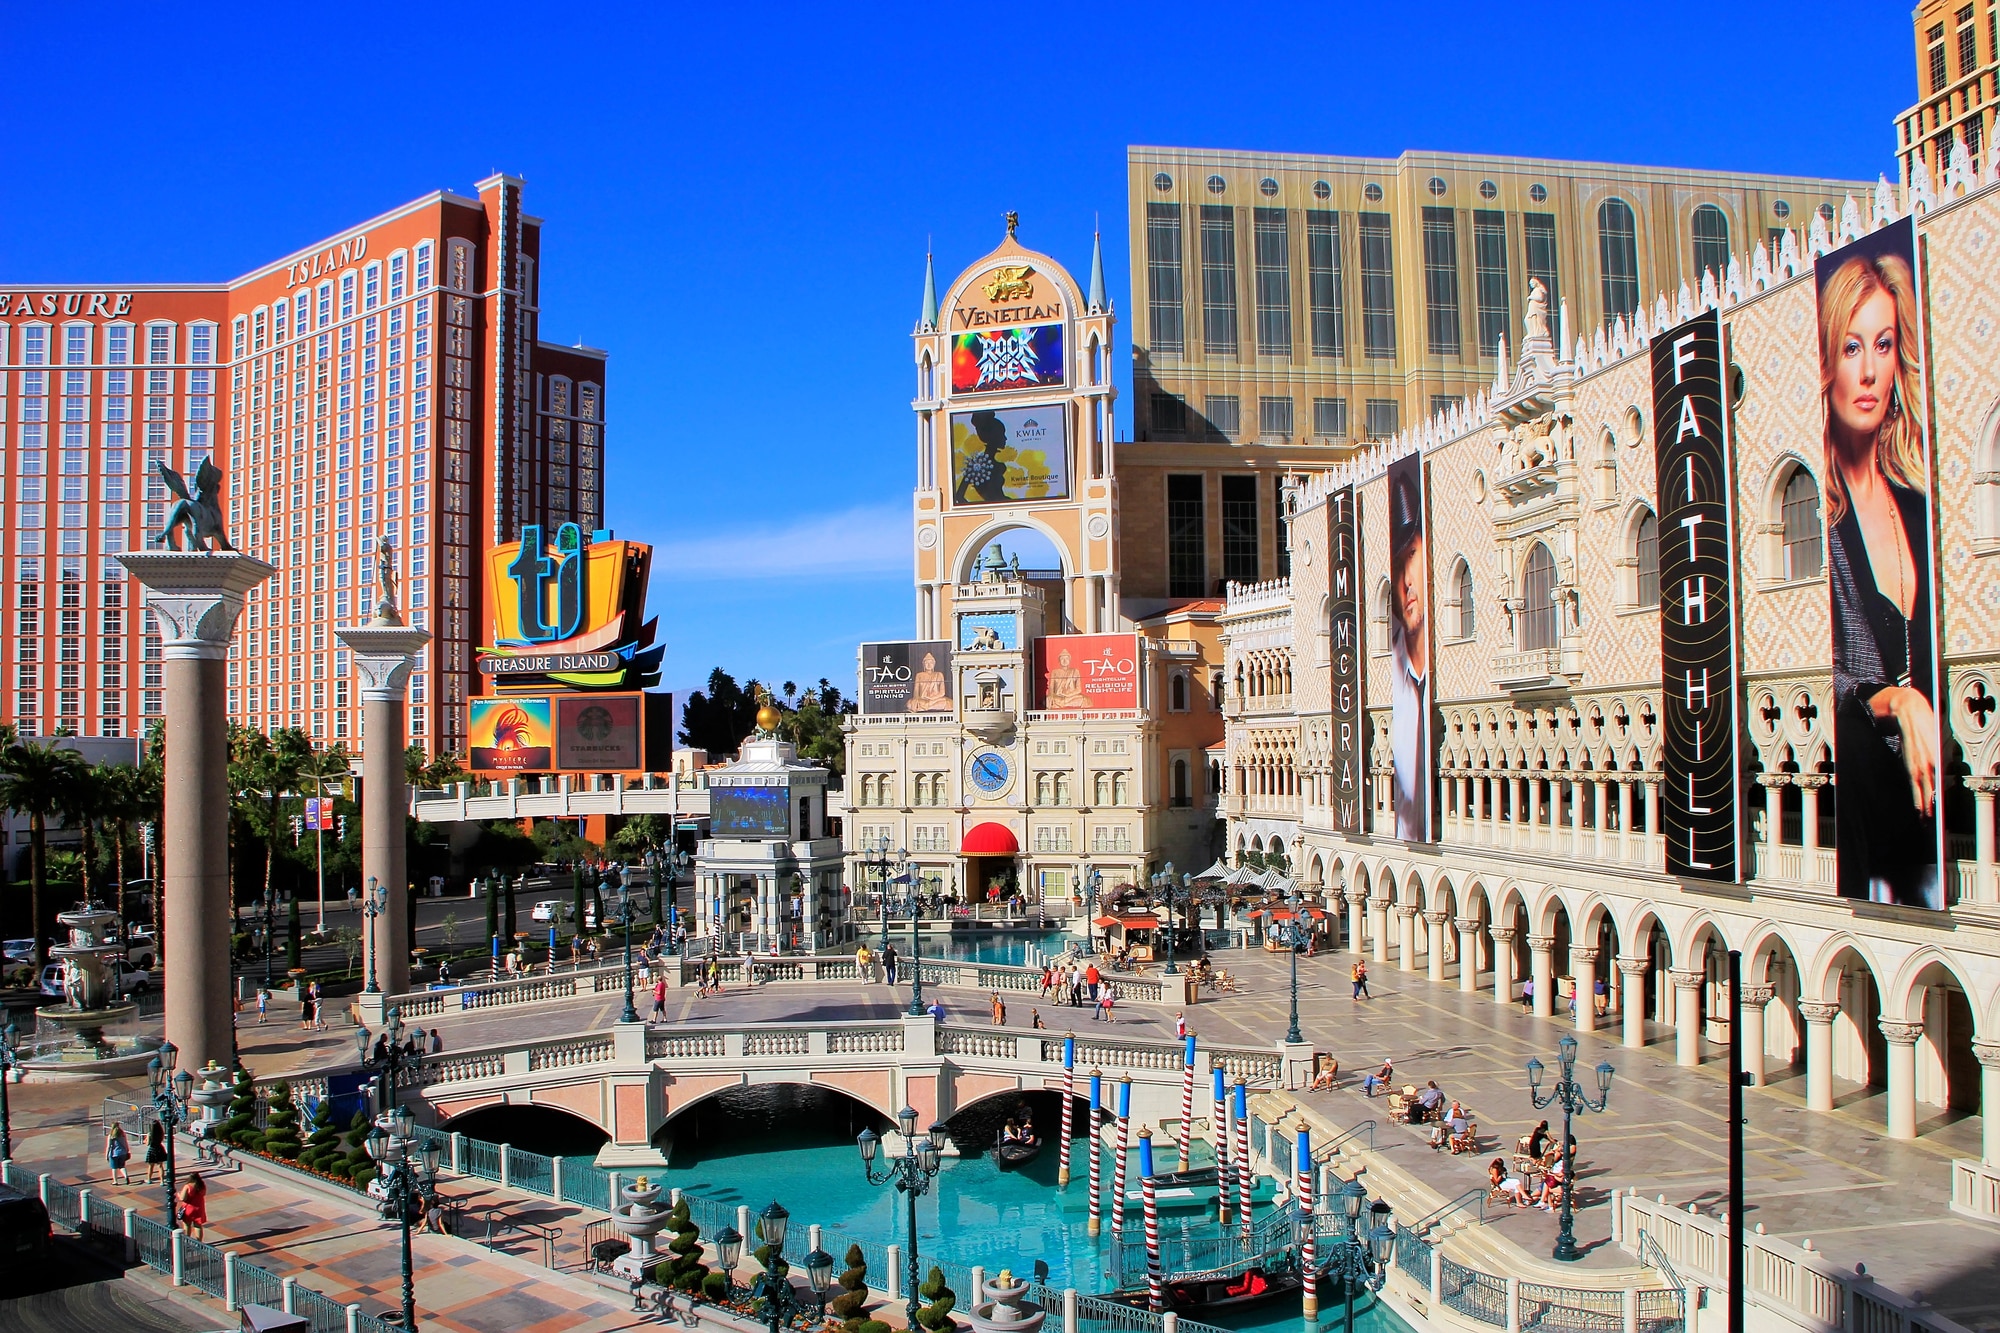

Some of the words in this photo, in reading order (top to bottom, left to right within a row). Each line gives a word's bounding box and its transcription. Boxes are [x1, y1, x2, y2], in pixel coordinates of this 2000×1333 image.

[286, 235, 367, 289] ISLAND
[955, 303, 1061, 329] VENETIAN
[975, 328, 1040, 367] ROCK
[975, 357, 1040, 389] AGES
[1016, 428, 1047, 438] KWIAT
[1030, 473, 1059, 481] Boutique
[1672, 331, 1707, 626] FAITH
[1334, 492, 1348, 599] TIM
[487, 656, 551, 672] TREASURE
[559, 655, 610, 670] ISLAND
[865, 665, 912, 683] TAO
[1082, 658, 1134, 676] TAO
[1685, 667, 1712, 869] HILL
